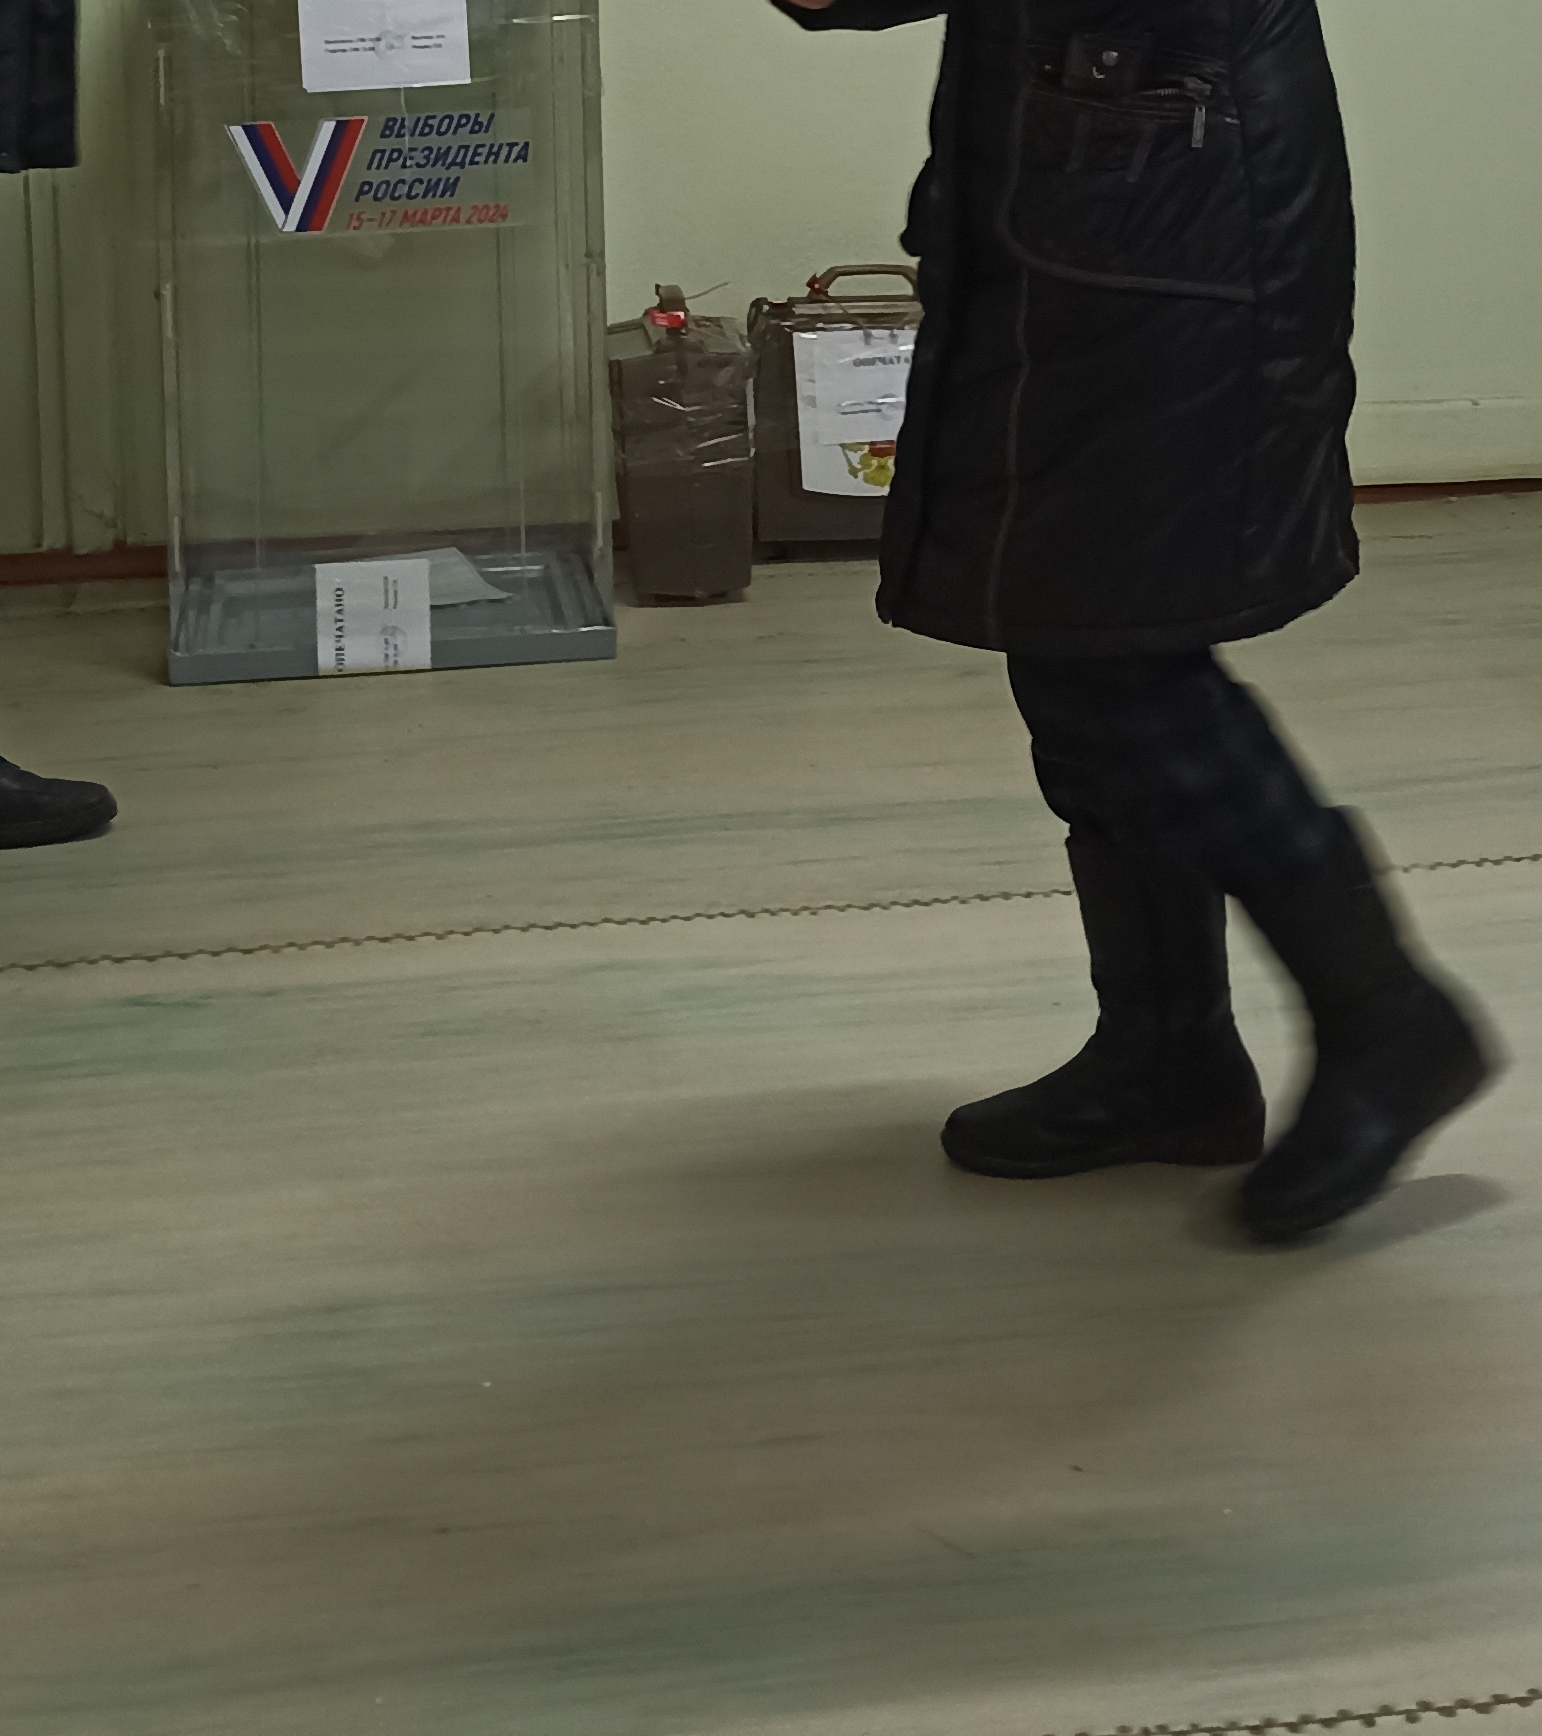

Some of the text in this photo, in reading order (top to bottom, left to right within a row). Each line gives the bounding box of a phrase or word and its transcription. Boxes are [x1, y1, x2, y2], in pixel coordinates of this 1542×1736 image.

[379, 112, 495, 139] ВЫБОРЫ
[366, 140, 530, 171] ПРЕЗИДЕНТА
[355, 175, 461, 202] РОССИИ
[399, 205, 462, 228] МАРТА
[465, 203, 509, 225] 2024
[334, 587, 346, 673] ОПЕЧАТАНО
